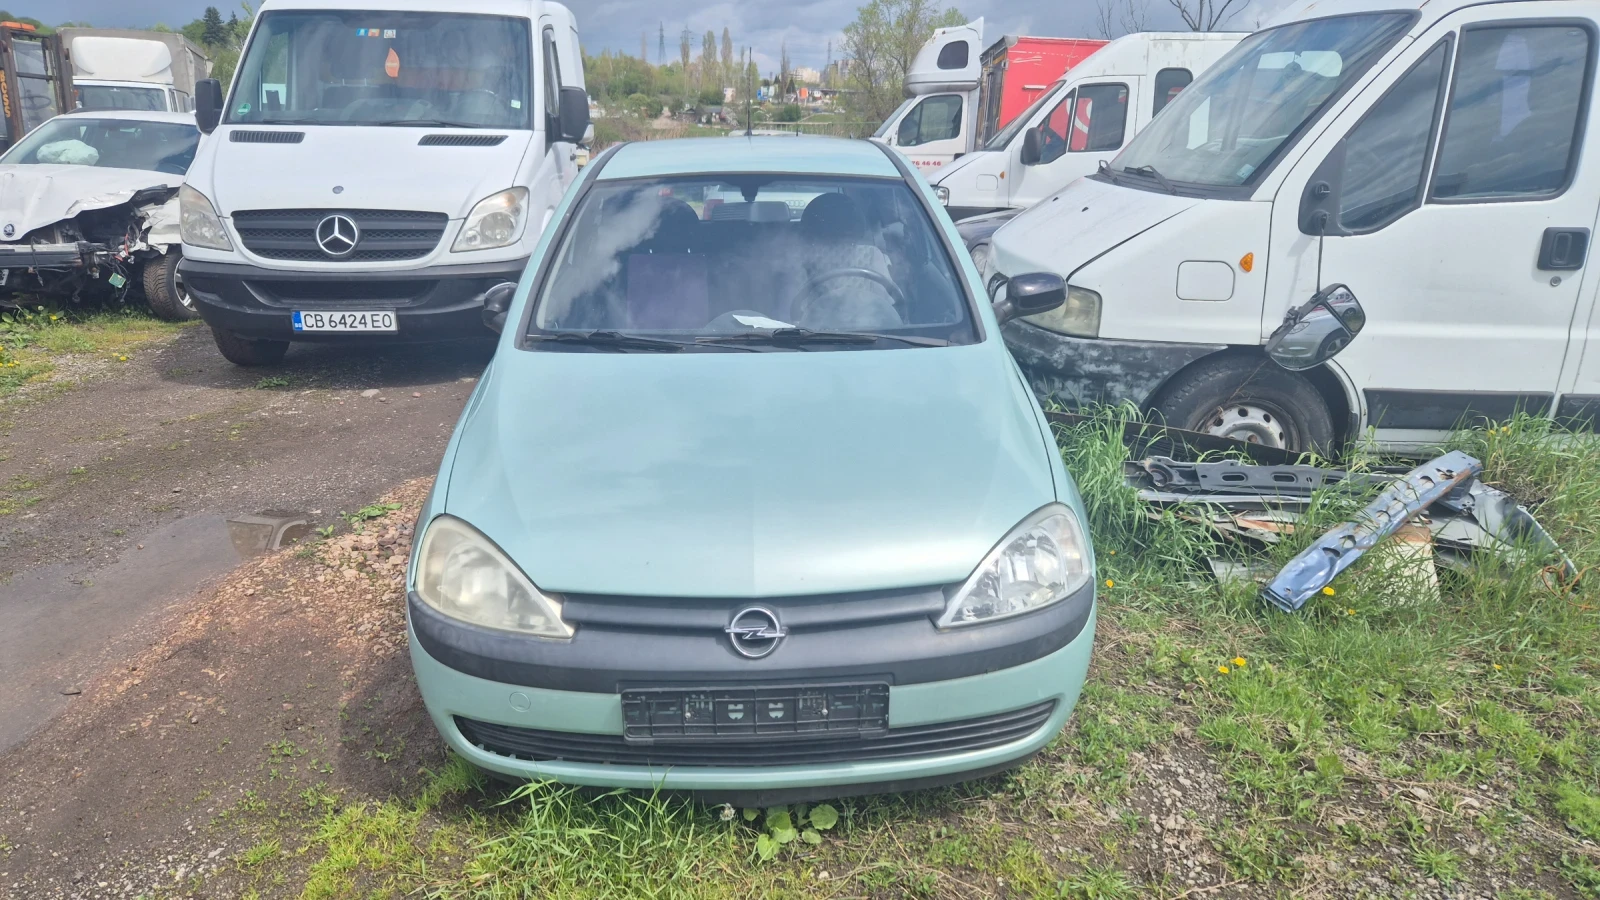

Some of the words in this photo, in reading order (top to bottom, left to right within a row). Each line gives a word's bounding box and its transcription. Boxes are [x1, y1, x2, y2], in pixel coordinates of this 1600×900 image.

[304, 314, 325, 328] CB
[328, 314, 368, 328] 6424
[371, 314, 392, 328] EO
